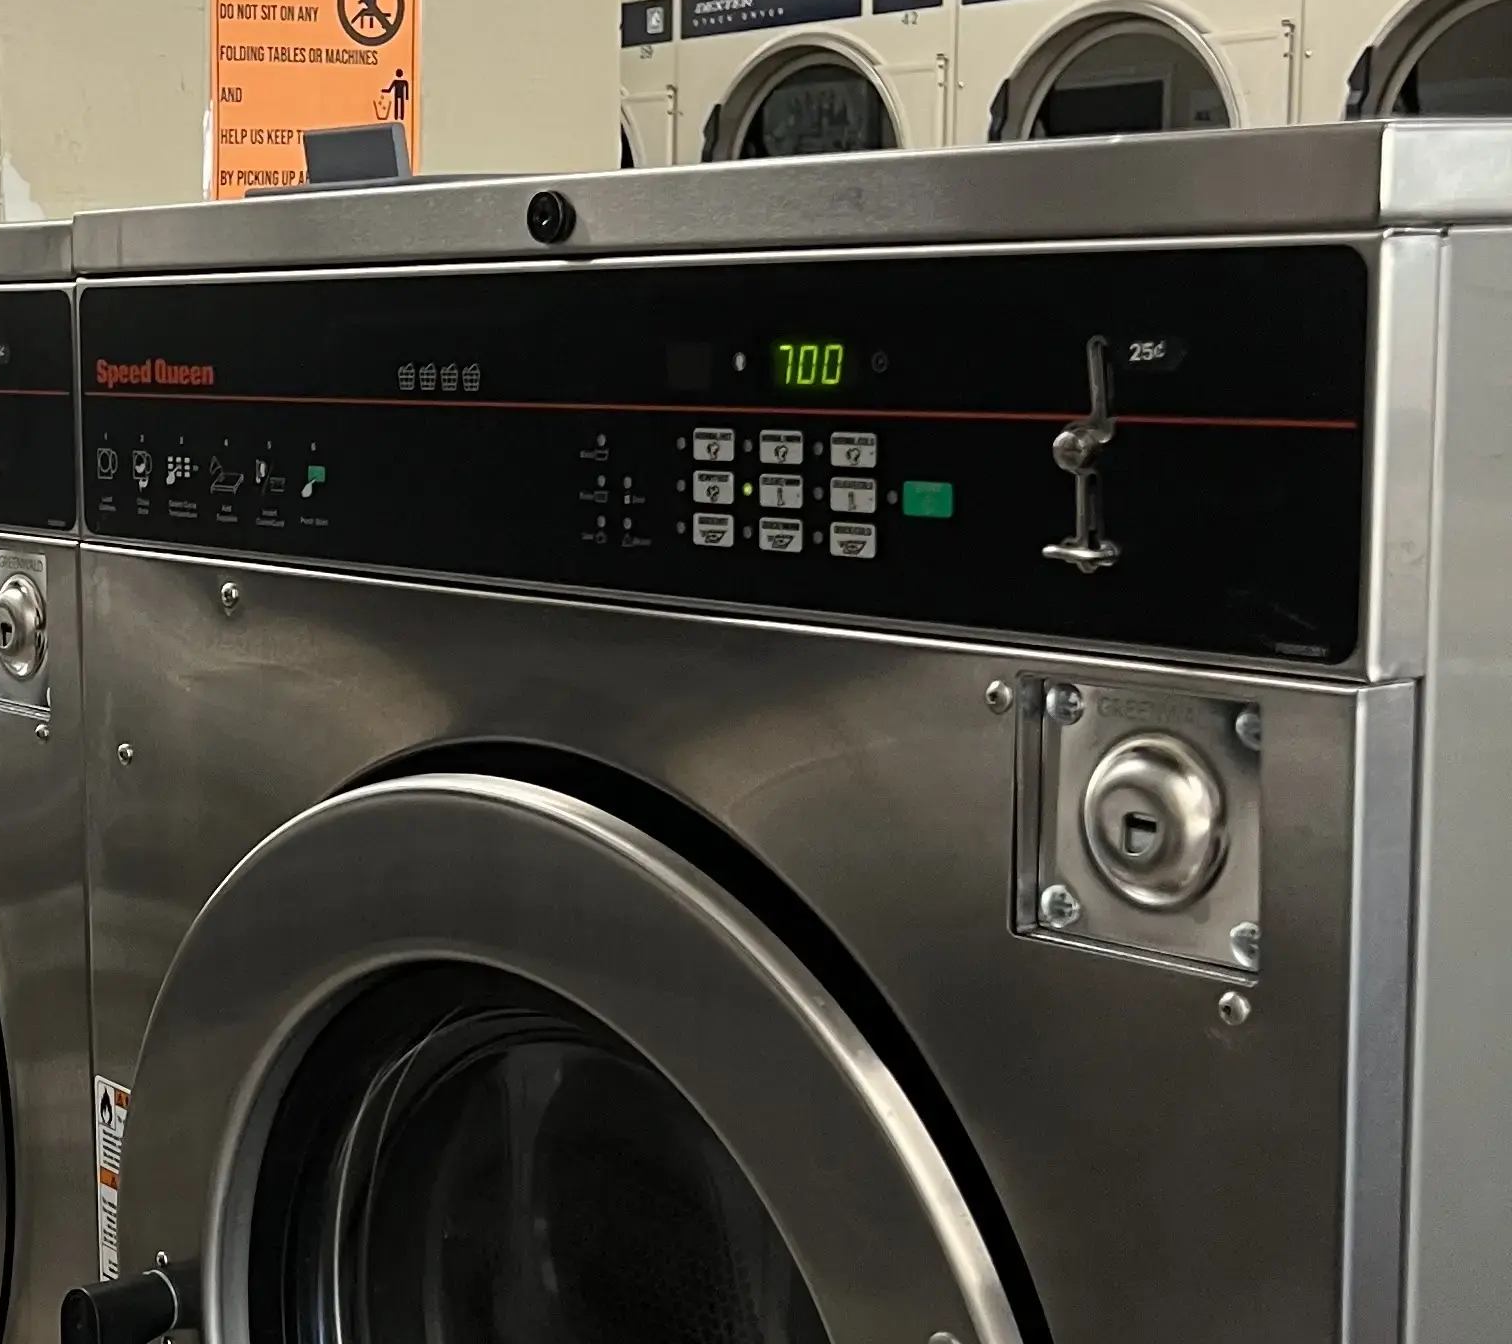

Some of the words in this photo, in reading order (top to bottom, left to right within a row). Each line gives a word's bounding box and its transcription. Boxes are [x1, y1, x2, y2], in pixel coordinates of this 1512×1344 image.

[219, 3, 234, 20] DO
[237, 3, 259, 20] NOT
[260, 4, 278, 21] SIT
[280, 5, 295, 22] ON
[297, 6, 320, 23] ANY
[219, 44, 265, 62] FOLDING
[267, 46, 306, 63] TABLES
[309, 47, 323, 63] OR
[325, 48, 378, 66] MACHINES
[220, 87, 243, 103] AND
[220, 128, 248, 145] HELP
[250, 128, 264, 145] US
[267, 128, 294, 145] KEEP
[220, 170, 234, 186] BY
[237, 170, 279, 186] PICKING
[282, 170, 296, 186] UP
[1128, 340, 1166, 362] 25¢
[96, 357, 152, 389] Speed
[154, 358, 214, 386] Queen
[778, 343, 844, 385] 700
